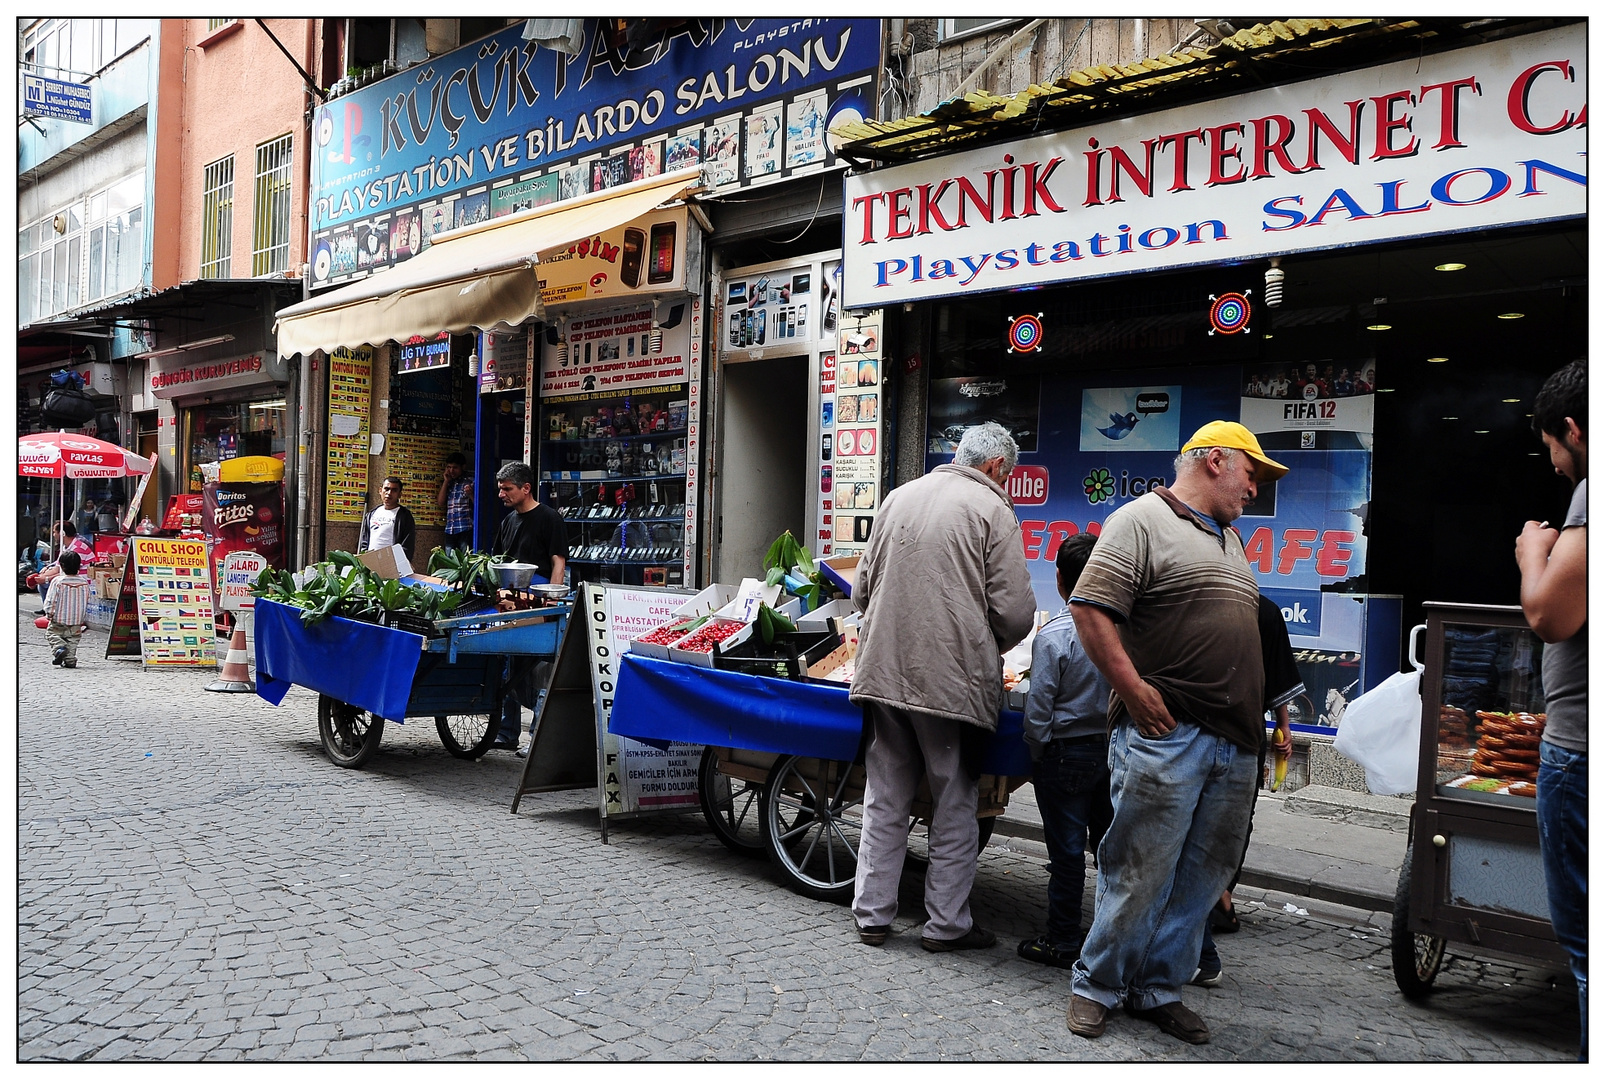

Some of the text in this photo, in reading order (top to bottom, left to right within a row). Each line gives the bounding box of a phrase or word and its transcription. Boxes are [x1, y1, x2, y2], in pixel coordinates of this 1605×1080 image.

[733, 18, 829, 53] PLAYSTA
[68, 97, 91, 110] GÜNDÜZ
[379, 39, 540, 159] KÜÇÜK
[315, 27, 853, 224] PLAYSTATİON VE BİLARDO SALONU
[852, 59, 1587, 245] TEKNİK İNTERNET C
[873, 152, 1587, 289] Playstation SALON
[557, 285, 583, 294] TELEFON
[571, 308, 652, 331] CEP TELEFON HASTANESİ
[570, 333, 583, 342] CEP
[584, 328, 614, 340] TELEFON
[350, 348, 371, 362] SHOP
[400, 341, 450, 360] LİG TV BURADA
[151, 354, 262, 388] GÜNGÖR KURUYEMİŞ
[579, 366, 592, 375] CEP
[593, 361, 626, 373] TELEFONU
[627, 358, 652, 369] TAMİRİ
[653, 355, 682, 366] YAPILIR
[612, 375, 624, 383] CEP
[624, 371, 657, 382] TELEFONU
[1137, 399, 1168, 410] twitter
[1284, 400, 1336, 419] FIFA 12
[217, 491, 247, 502] Doritos
[214, 504, 254, 525] Fritos
[139, 542, 204, 557] CALL SHOP
[1232, 526, 1358, 578] AFE
[176, 557, 205, 567] TELEFON
[226, 586, 254, 598] PLAYSTA
[649, 606, 670, 616] CAFE
[614, 615, 669, 626] PLAYSTATİO
[675, 749, 690, 757] SINAV
[668, 759, 688, 768] BAKILIR
[606, 753, 621, 804] FAX
[628, 768, 666, 780] GEMİCİLER
[667, 767, 681, 780] İÇİN
[641, 782, 666, 793] FORMU
